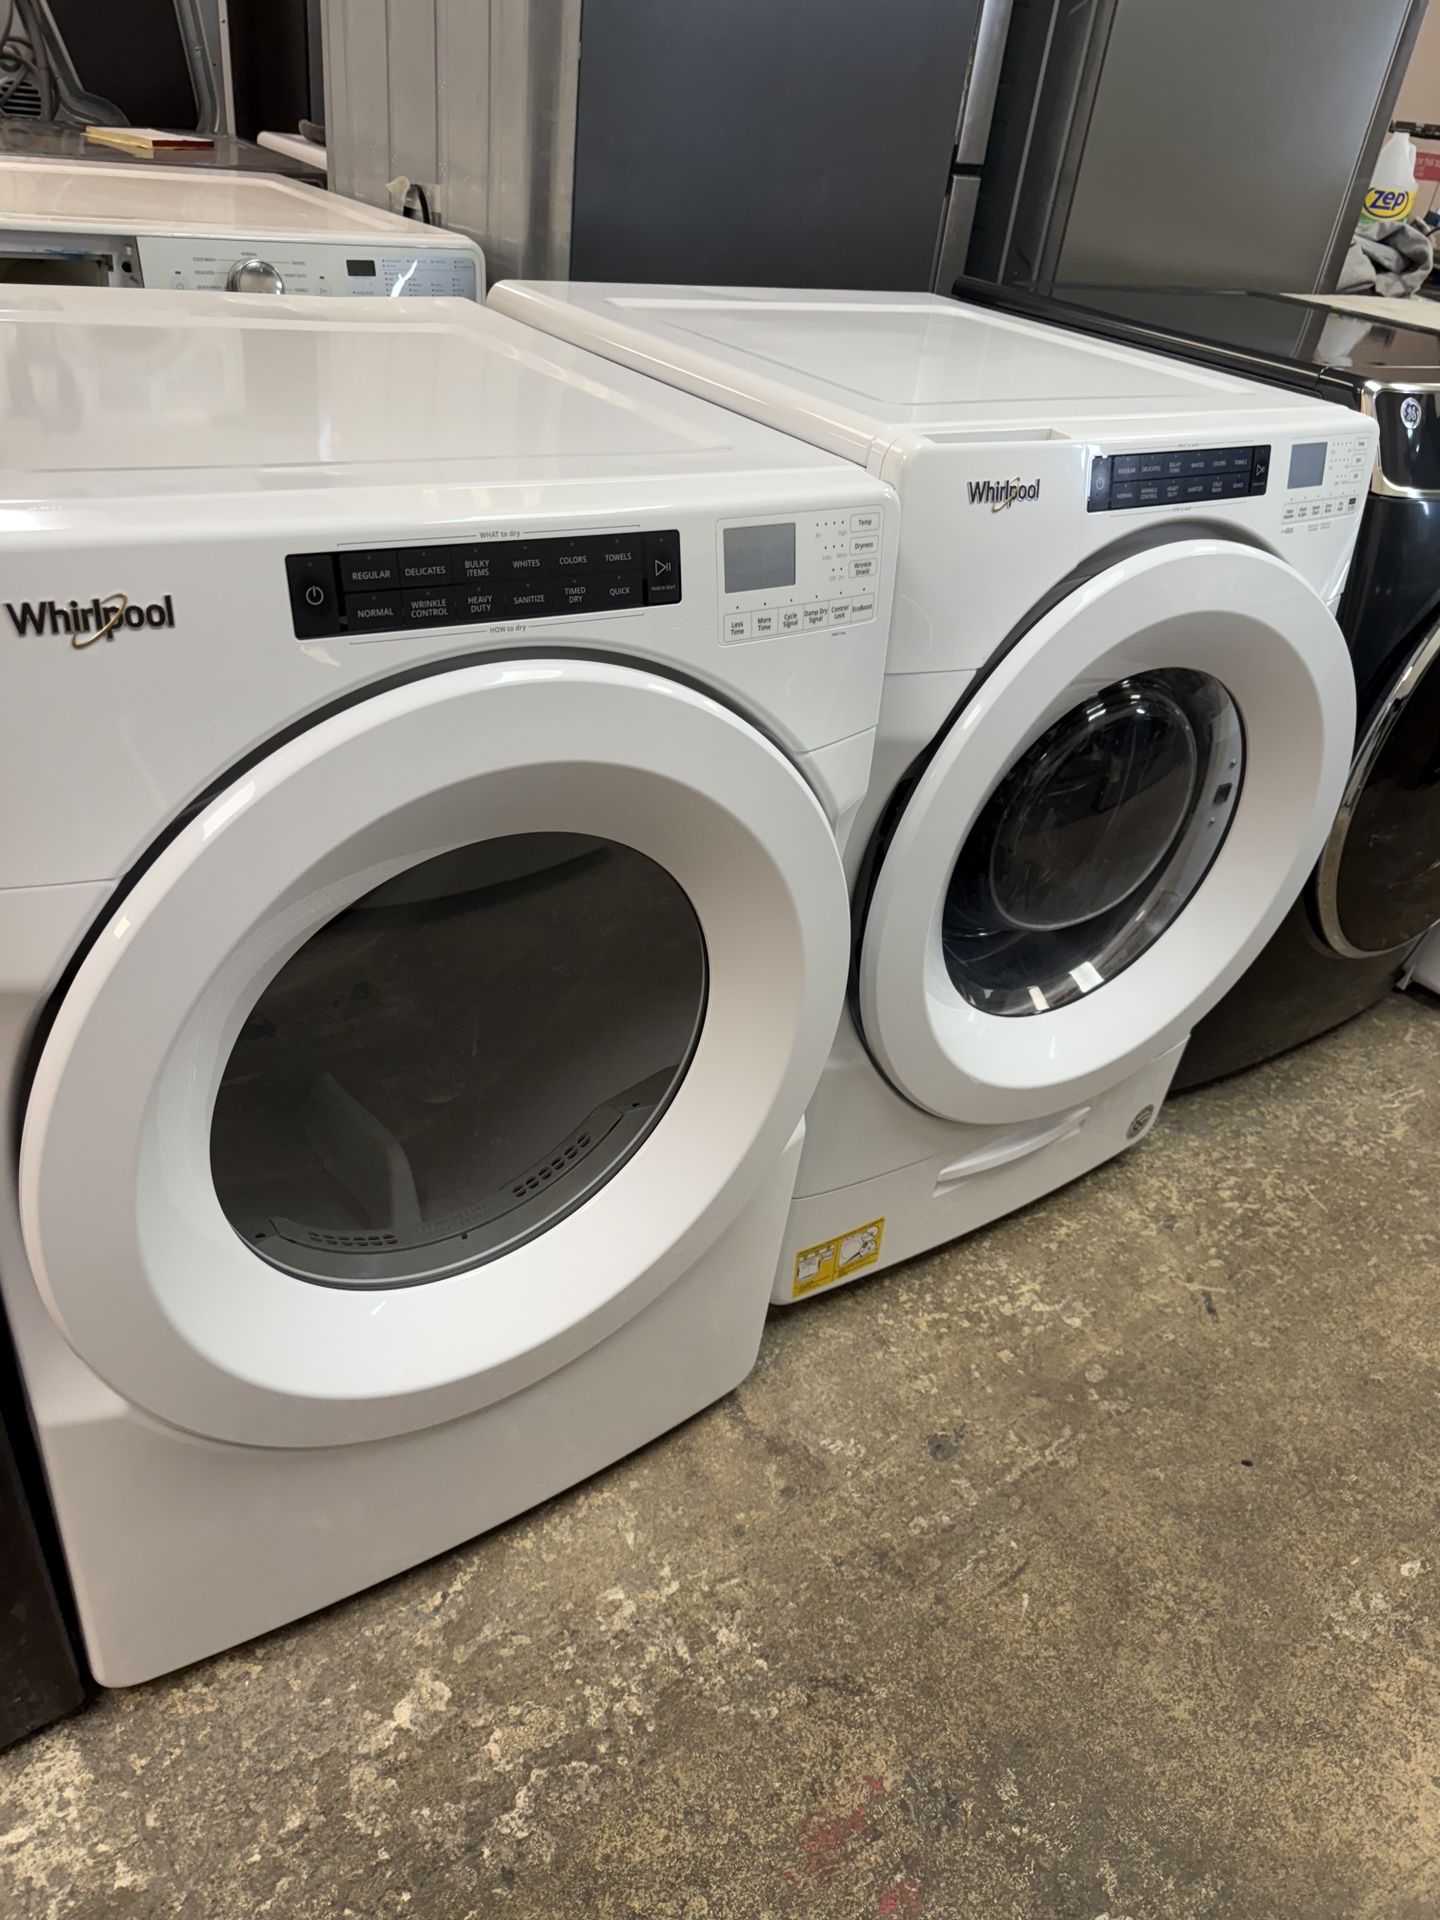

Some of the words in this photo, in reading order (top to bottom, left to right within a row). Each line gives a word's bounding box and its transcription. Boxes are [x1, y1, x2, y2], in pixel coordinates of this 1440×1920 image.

[1369, 189, 1407, 211] Zep
[967, 478, 1041, 510] Whirlpool
[858, 519, 872, 527] Temp
[480, 531, 499, 539] WHAT
[508, 530, 521, 539] dry
[854, 542, 874, 551] Dryness
[559, 555, 587, 565] COLORS
[605, 552, 632, 562] TOWELS
[464, 559, 490, 569] BULKY
[512, 558, 541, 569] WHITES
[853, 561, 872, 569] Wrinkle
[352, 570, 391, 581] REGULAR
[404, 566, 446, 577] DELICATES
[466, 567, 490, 577] ITEMS
[855, 568, 870, 576] Shield
[564, 586, 586, 596] TIMED
[609, 586, 631, 597] QUICK
[411, 598, 447, 609] WRINKLE
[467, 594, 493, 604] HEAVY
[513, 594, 545, 605] SANITIZE
[569, 595, 583, 604] DRY
[411, 607, 448, 618] CONTROL
[470, 603, 492, 613] DUTY
[819, 607, 828, 616] Dry
[831, 603, 850, 613] Control
[357, 608, 394, 619] NORMAL
[784, 612, 798, 621] Cycle
[834, 612, 845, 620] Lock
[4, 594, 176, 644] Whirlpool
[783, 618, 799, 629] Signal
[809, 615, 824, 625] Signal
[489, 625, 506, 633] HOW
[515, 624, 527, 632] dry
[731, 621, 744, 629] Less
